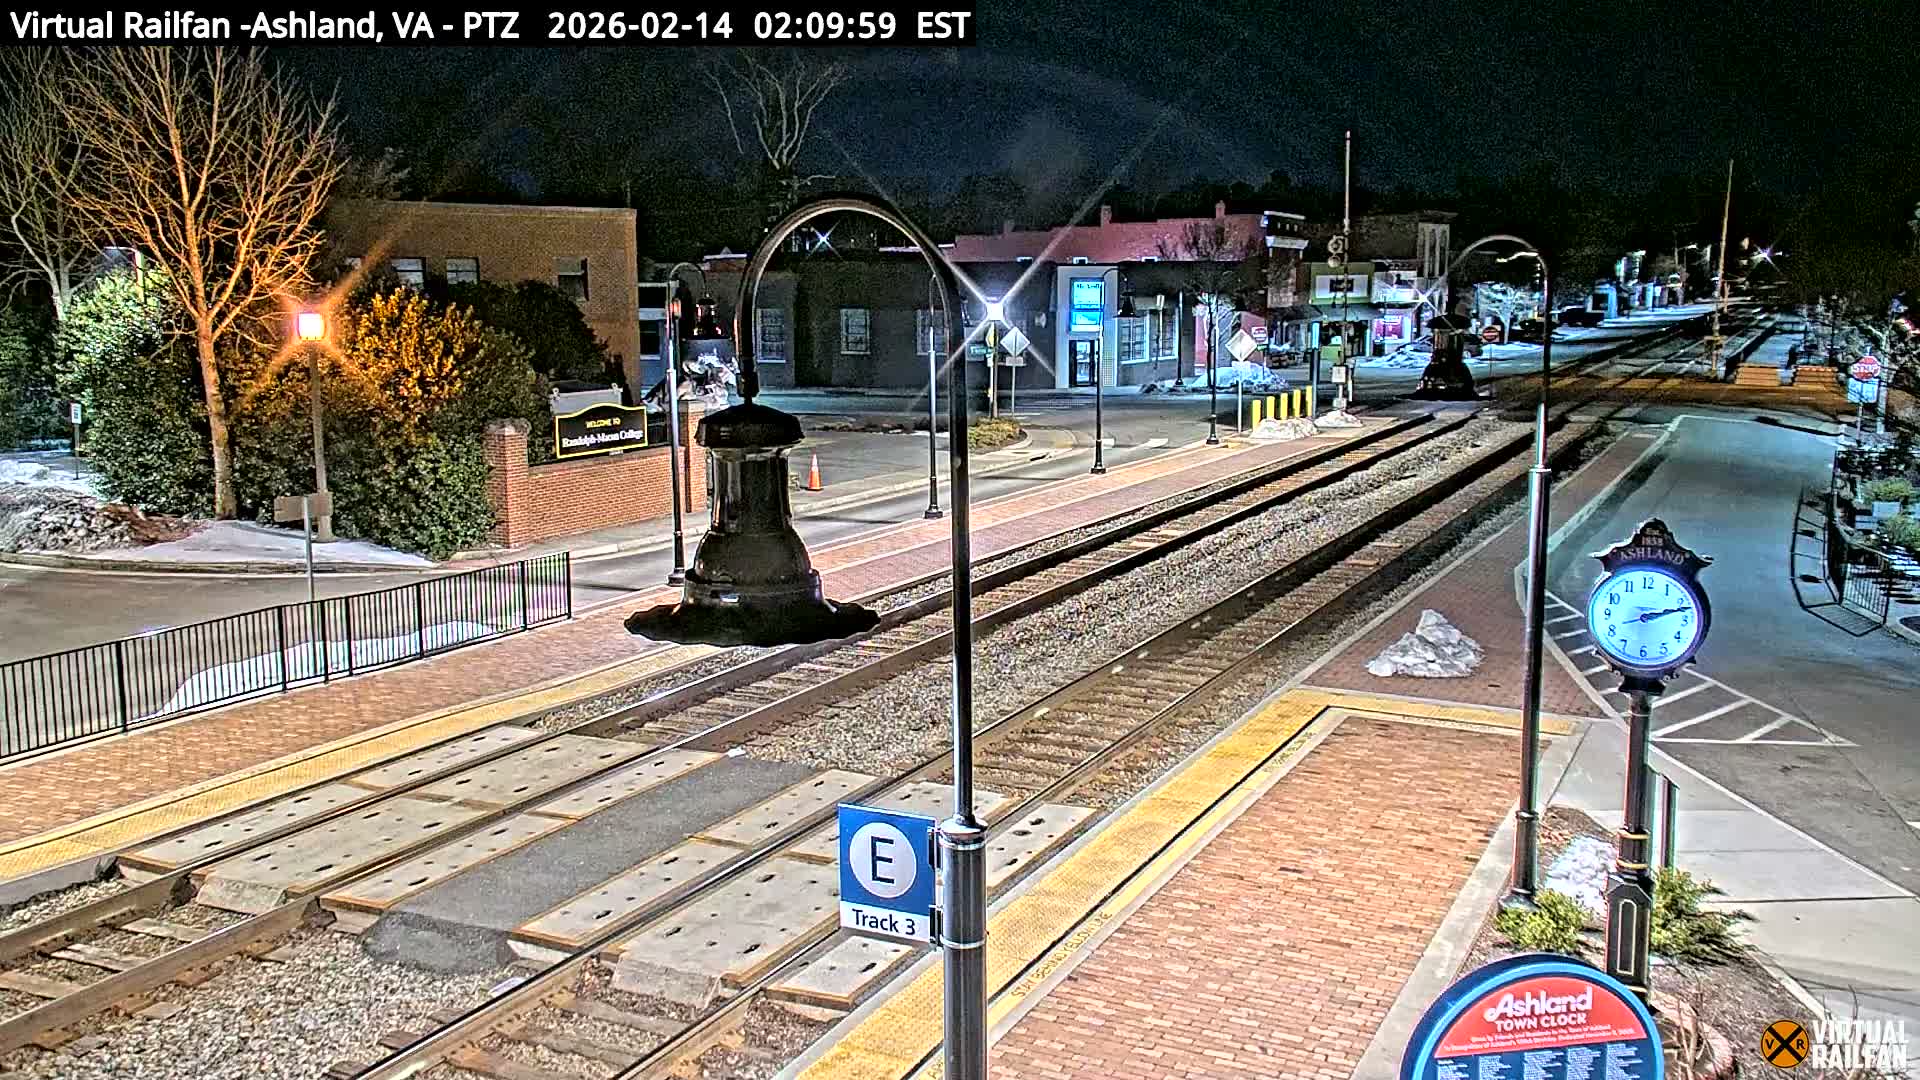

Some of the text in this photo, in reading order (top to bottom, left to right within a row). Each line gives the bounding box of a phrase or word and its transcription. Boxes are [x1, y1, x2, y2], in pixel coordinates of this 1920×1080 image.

[1850, 363, 1880, 377] STOP
[612, 417, 621, 425] TO
[620, 429, 643, 439] College
[1620, 547, 1685, 565] ASHLAND
[1624, 581, 1634, 593] 11
[1642, 577, 1655, 590] 12
[1664, 584, 1670, 596] 1
[1609, 593, 1621, 605] 10
[1676, 598, 1685, 608] 2
[1604, 608, 1611, 620] 9
[1680, 616, 1689, 627] 3
[1608, 624, 1617, 638] 8
[1674, 630, 1682, 643] 4
[1620, 639, 1628, 653] 7
[1639, 645, 1648, 658] 6
[1659, 642, 1669, 655] 5
[870, 835, 895, 884] E
[852, 908, 916, 936] Track 3
[1483, 986, 1593, 1022] Ashland
[1494, 1012, 1587, 1032] TOWN CLOCK
